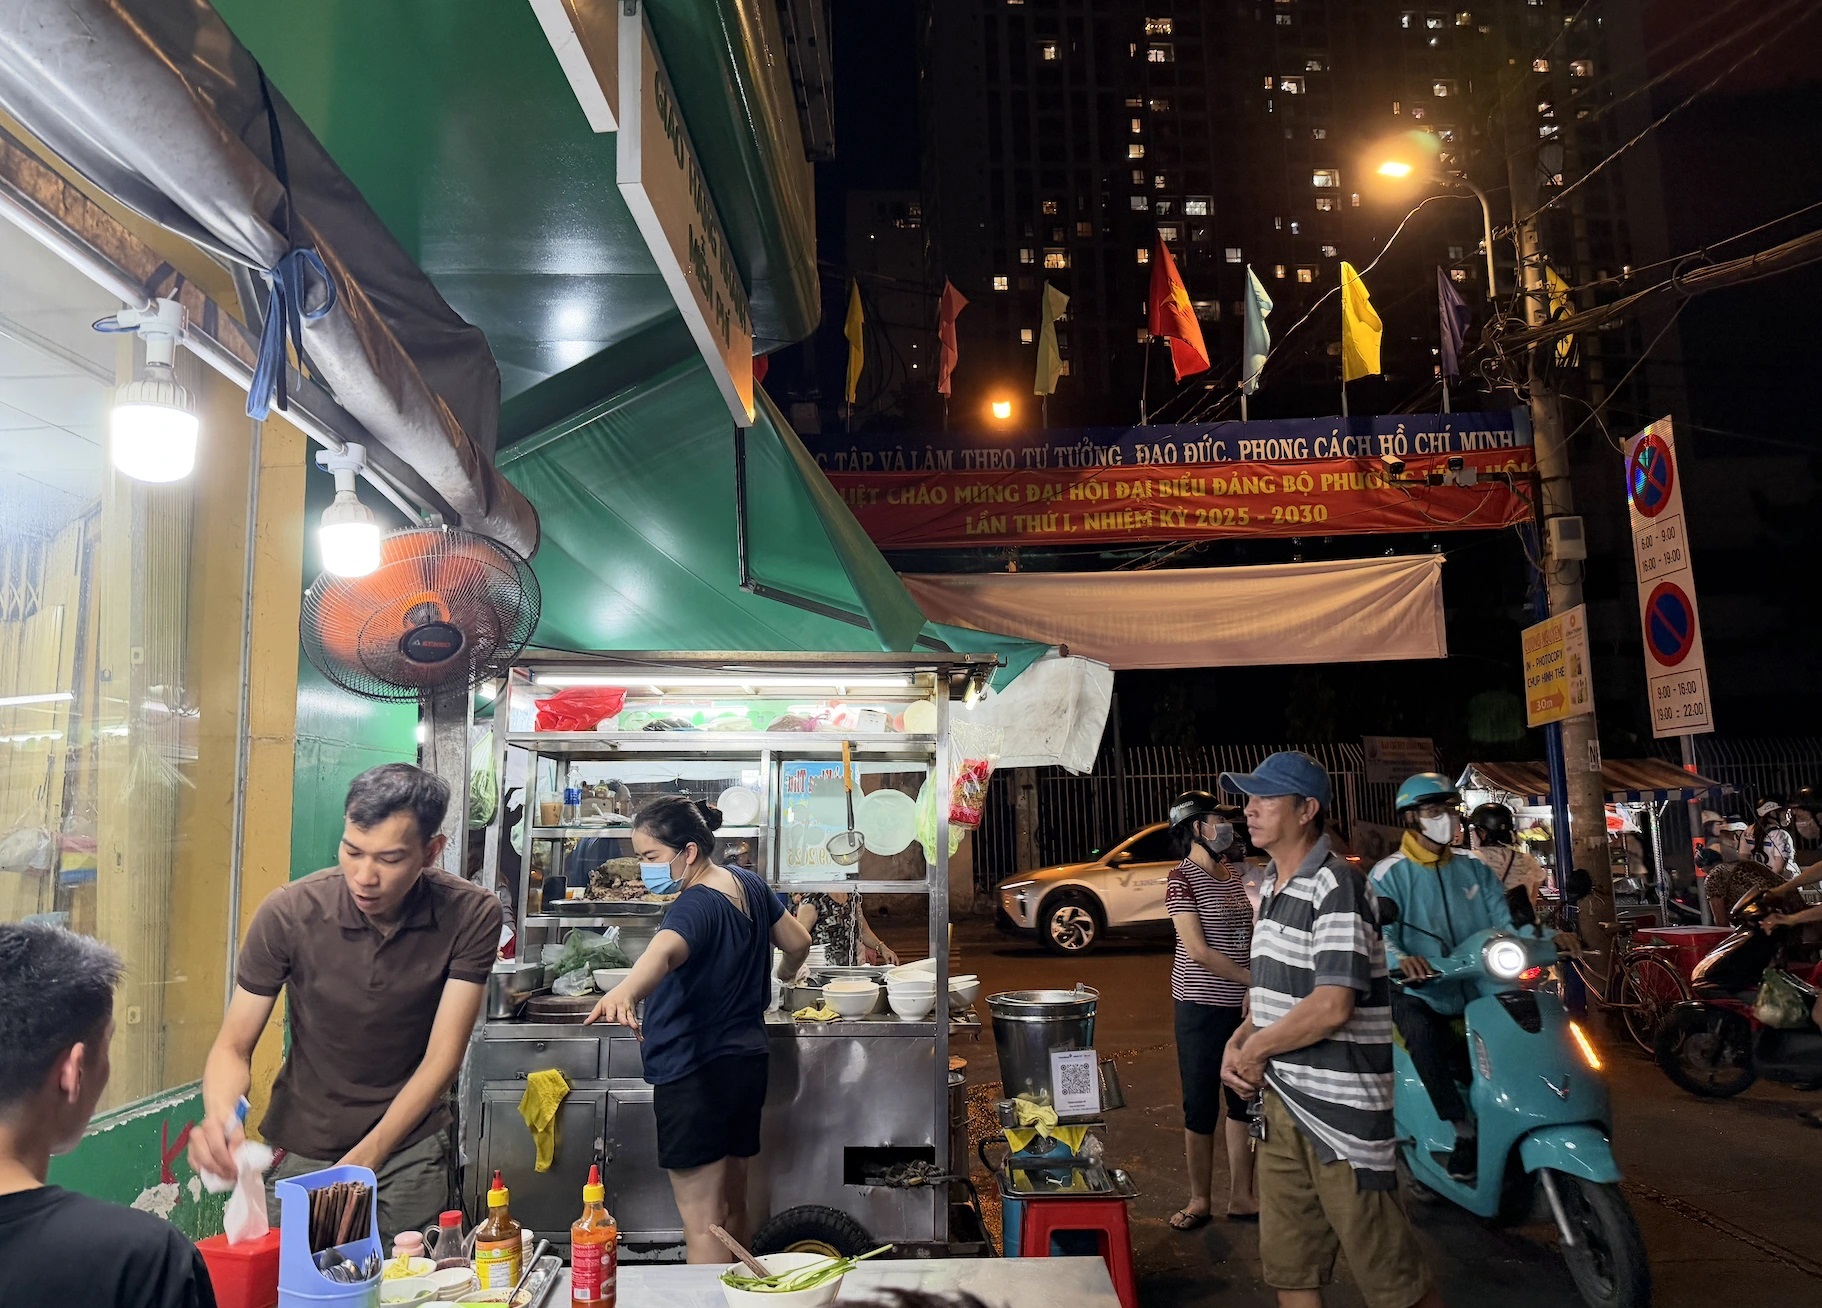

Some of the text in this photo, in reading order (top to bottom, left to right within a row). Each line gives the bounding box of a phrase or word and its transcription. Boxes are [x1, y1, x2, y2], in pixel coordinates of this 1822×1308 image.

[910, 445, 954, 471] LÀM
[961, 448, 1016, 470] THEO
[1054, 436, 1122, 468] TƯỞNG
[1238, 437, 1309, 461] PHONG
[1314, 428, 1373, 459] CÁCH
[1378, 423, 1408, 456] HỒ
[1415, 424, 1451, 454] CHÍ
[1459, 430, 1514, 451] MINH
[886, 482, 948, 506] CHÀO
[1026, 483, 1063, 505] ĐẠI
[1069, 479, 1110, 504] HỘI
[1115, 480, 1152, 503] ĐẠI
[1159, 471, 1206, 498] BIỂU
[1212, 471, 1276, 496] ĐẢNG
[1282, 470, 1314, 497] BỘ
[966, 510, 1007, 535] LẦN
[1013, 510, 1060, 533] THỨ
[1083, 507, 1153, 533] NHIỆM
[1160, 505, 1189, 528] KỲ
[1195, 507, 1250, 527] 2025
[1271, 504, 1328, 525] 2030
[1536, 649, 1563, 667] PHOTOCOPY
[1536, 698, 1553, 711] 30m
[1683, 702, 1704, 717] 22:00
